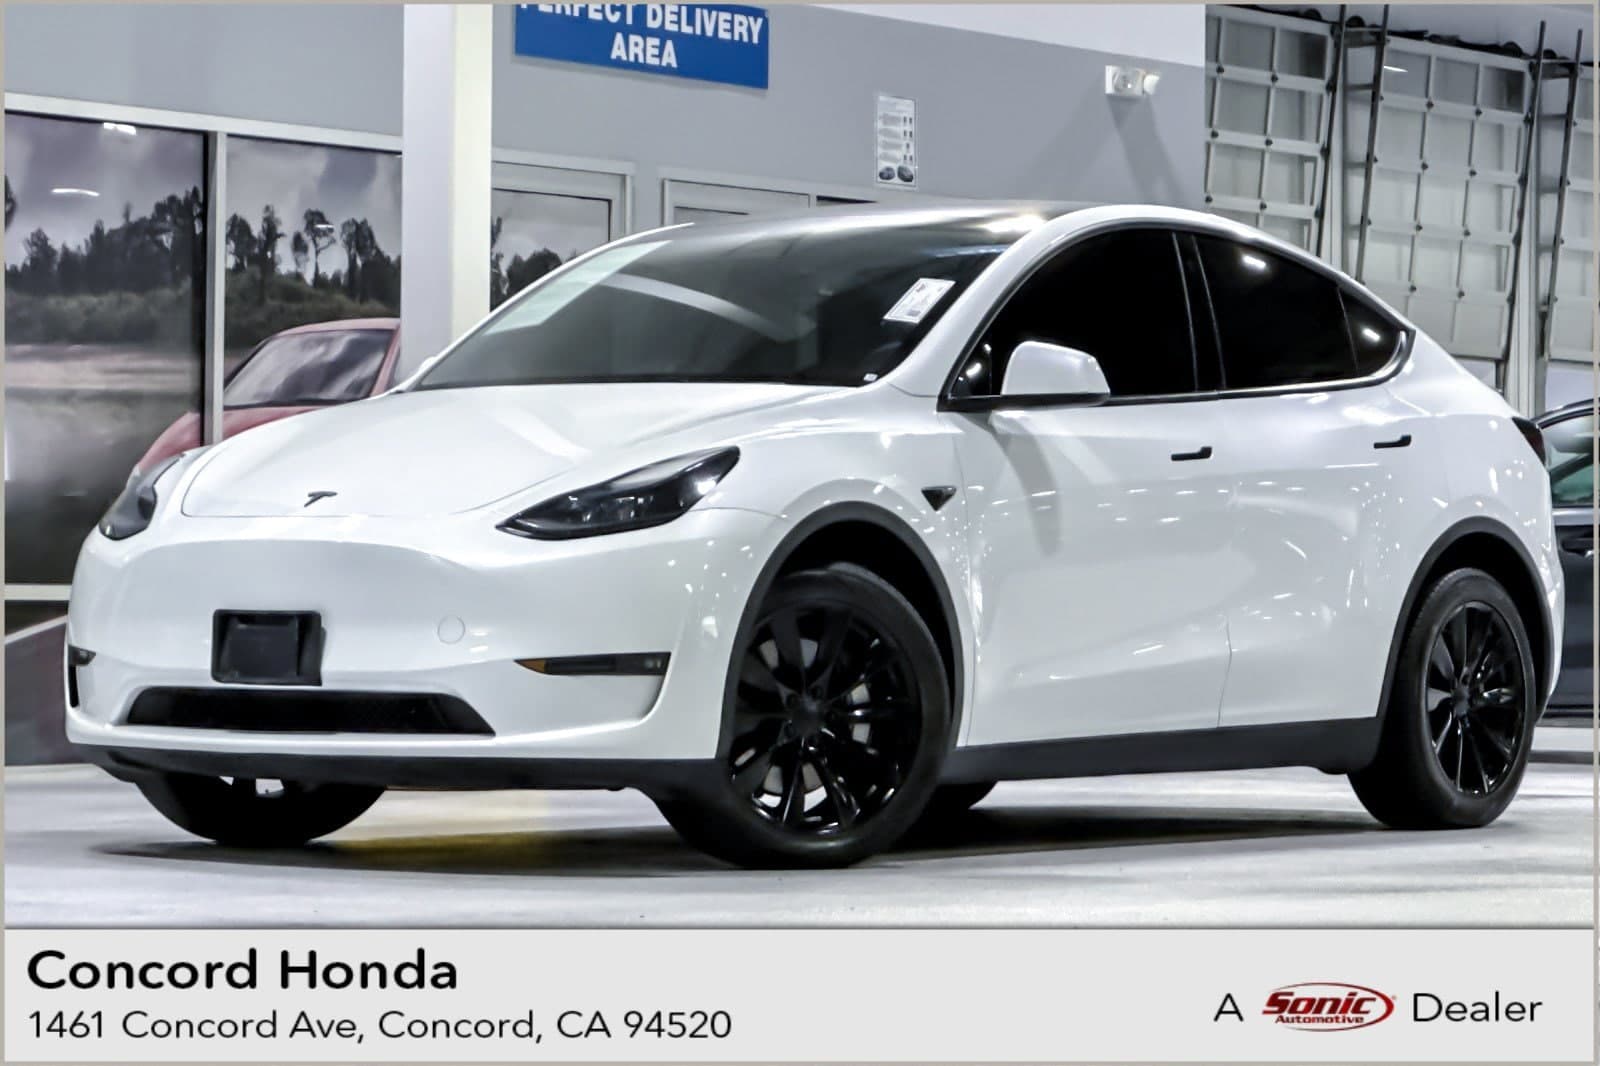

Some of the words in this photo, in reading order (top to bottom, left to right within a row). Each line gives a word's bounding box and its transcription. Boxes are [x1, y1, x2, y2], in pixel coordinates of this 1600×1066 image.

[520, 4, 637, 25] FECT
[646, 4, 763, 44] DELIVERY
[610, 32, 678, 68] AREA
